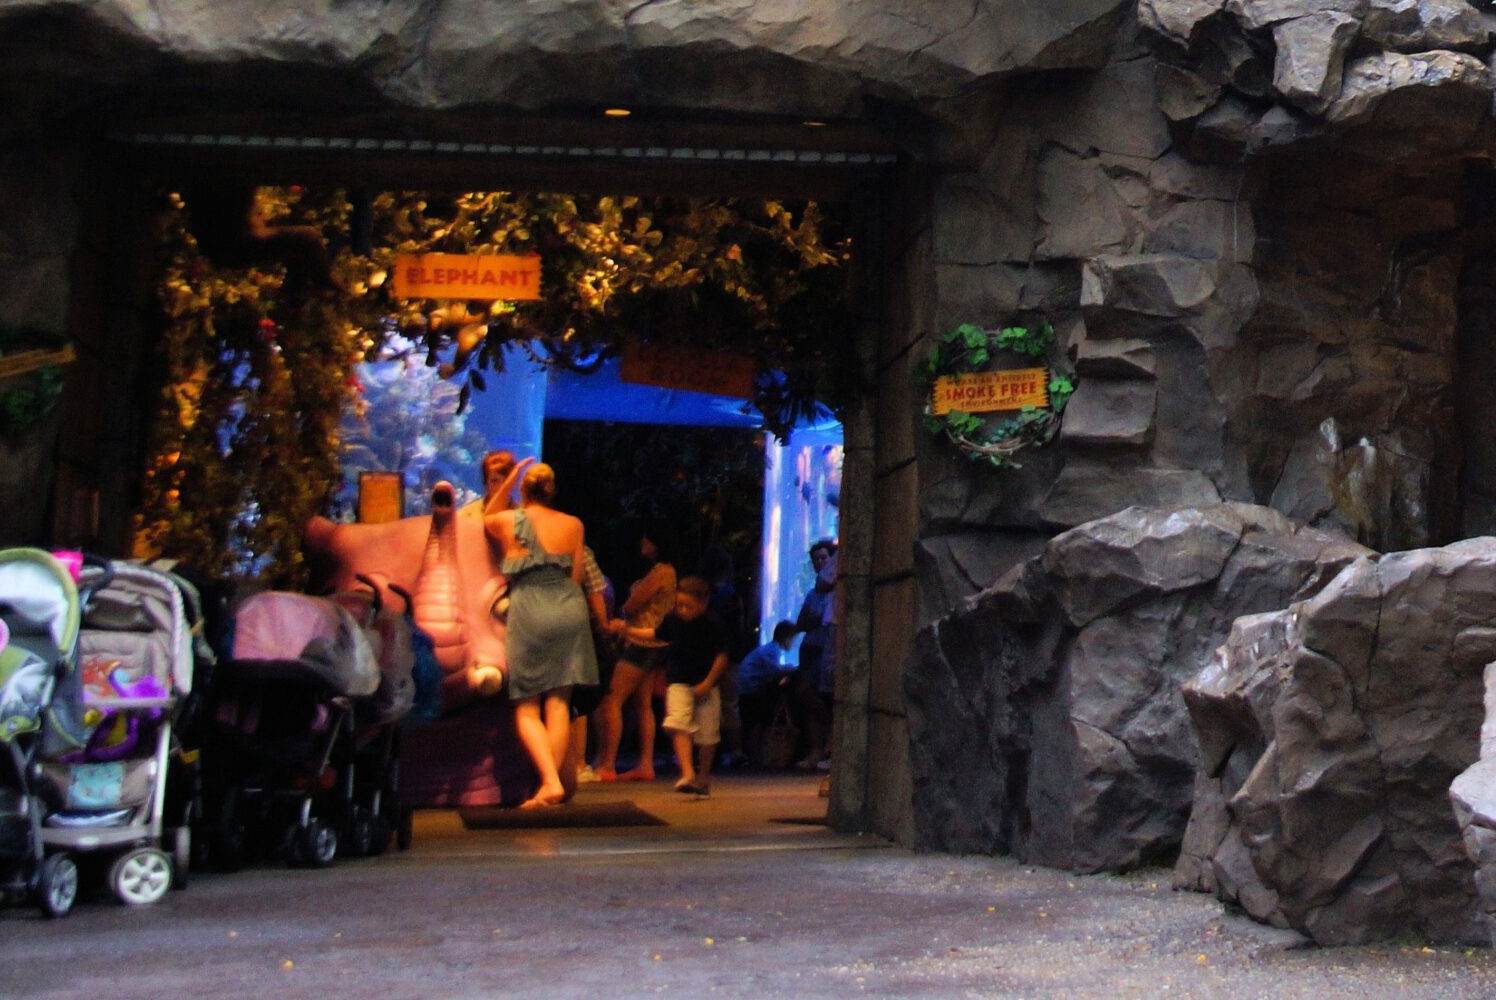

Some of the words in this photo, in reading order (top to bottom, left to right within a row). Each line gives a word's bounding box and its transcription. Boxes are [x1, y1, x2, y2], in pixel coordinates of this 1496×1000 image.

[406, 266, 533, 287] ELEPHANT
[945, 384, 995, 400] SMOKE
[1001, 382, 1037, 396] FREE
